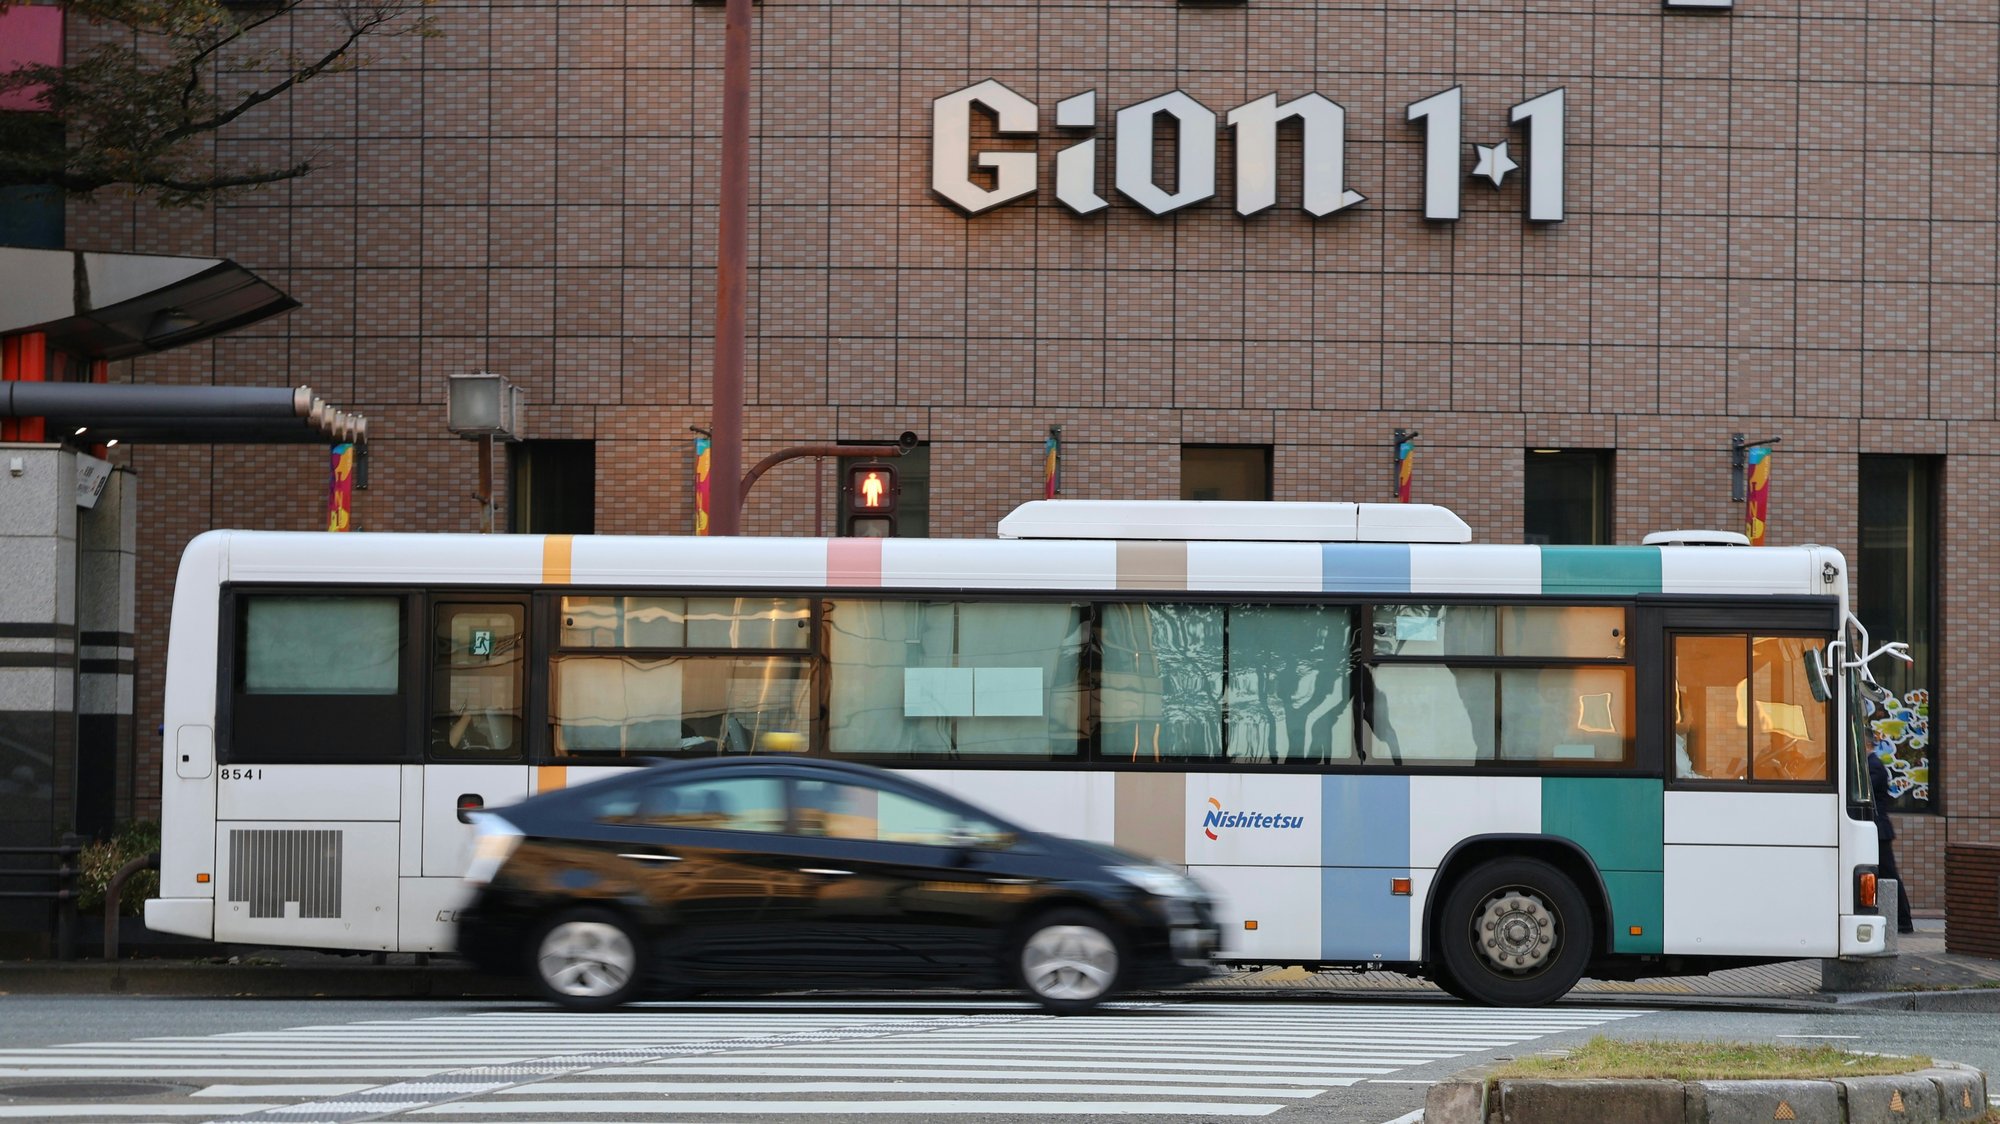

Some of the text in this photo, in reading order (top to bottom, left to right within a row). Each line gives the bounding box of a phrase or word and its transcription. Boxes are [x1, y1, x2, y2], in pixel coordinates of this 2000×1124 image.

[931, 78, 1367, 217] Gion
[221, 768, 262, 780] 8541
[1203, 810, 1304, 829] Nishitetsu
